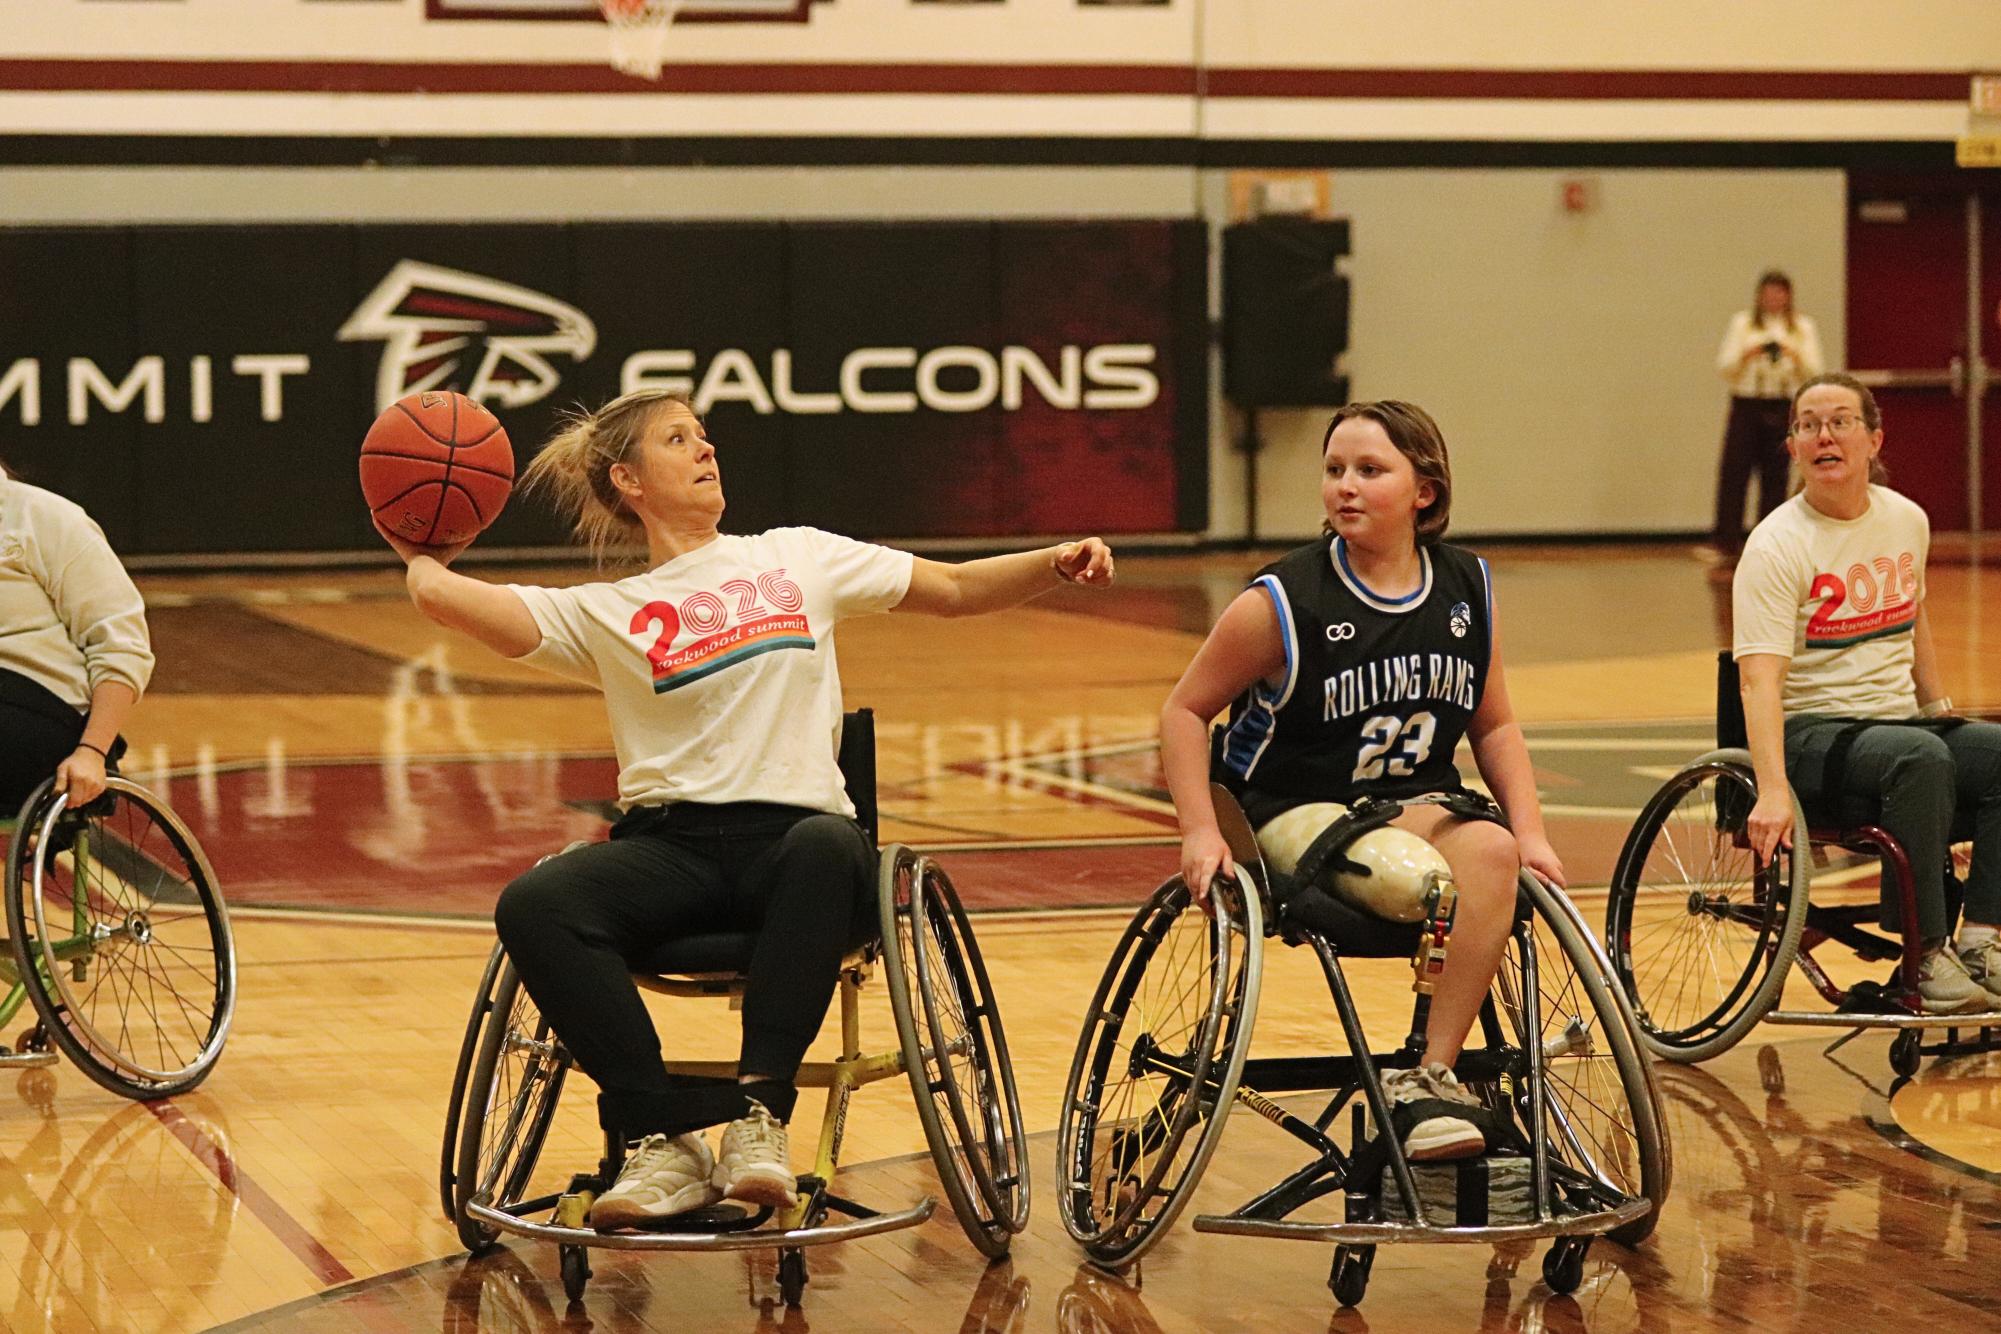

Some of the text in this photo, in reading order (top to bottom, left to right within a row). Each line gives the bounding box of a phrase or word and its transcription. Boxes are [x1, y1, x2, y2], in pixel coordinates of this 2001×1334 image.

[620, 343, 1160, 415] FALCONS
[630, 568, 803, 660] 2026
[1807, 551, 1916, 626] 2026
[1815, 611, 1883, 633] rockwood
[656, 618, 805, 671] rockwood summit
[1323, 653, 1475, 722] ROLLING RAMS
[1352, 711, 1437, 783] 23
